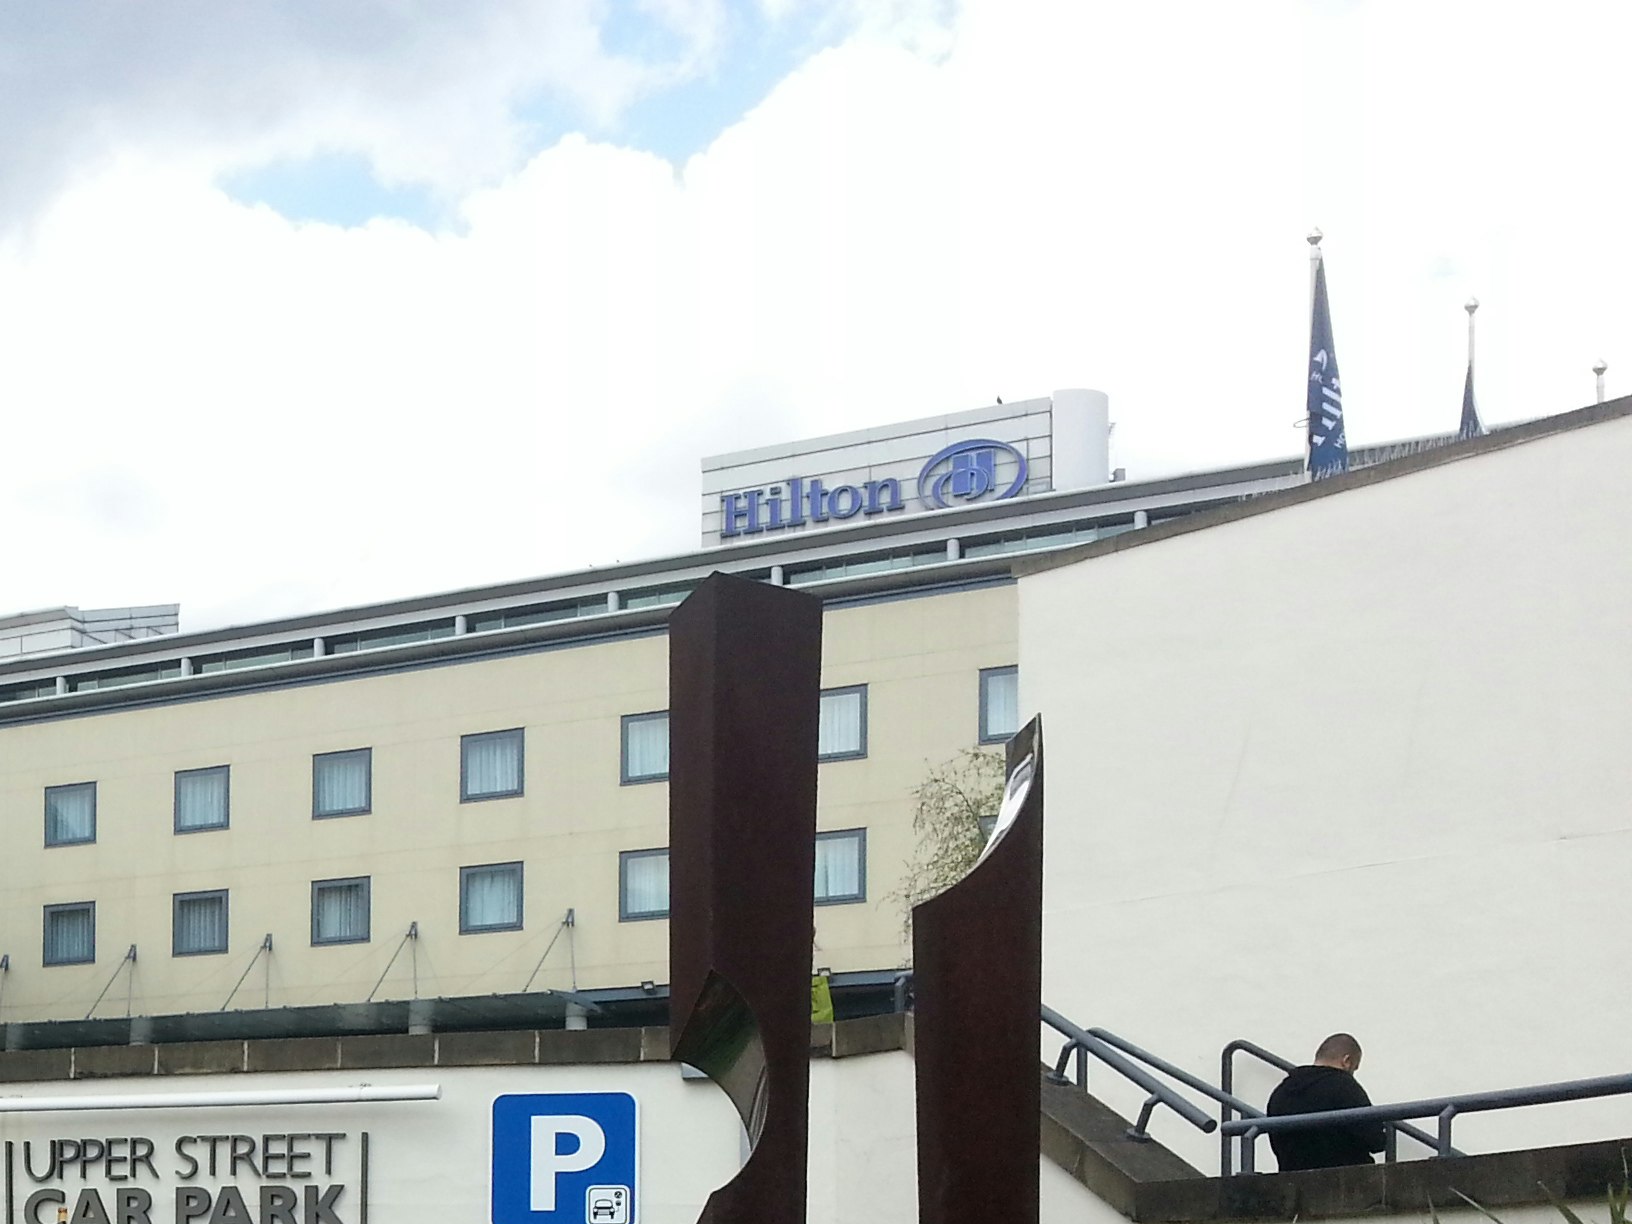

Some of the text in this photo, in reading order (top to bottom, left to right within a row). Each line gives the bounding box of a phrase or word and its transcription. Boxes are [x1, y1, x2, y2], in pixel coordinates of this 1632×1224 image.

[720, 476, 905, 538] Hilton
[23, 1132, 346, 1183] UPPER STREET
[530, 1115, 606, 1212] P
